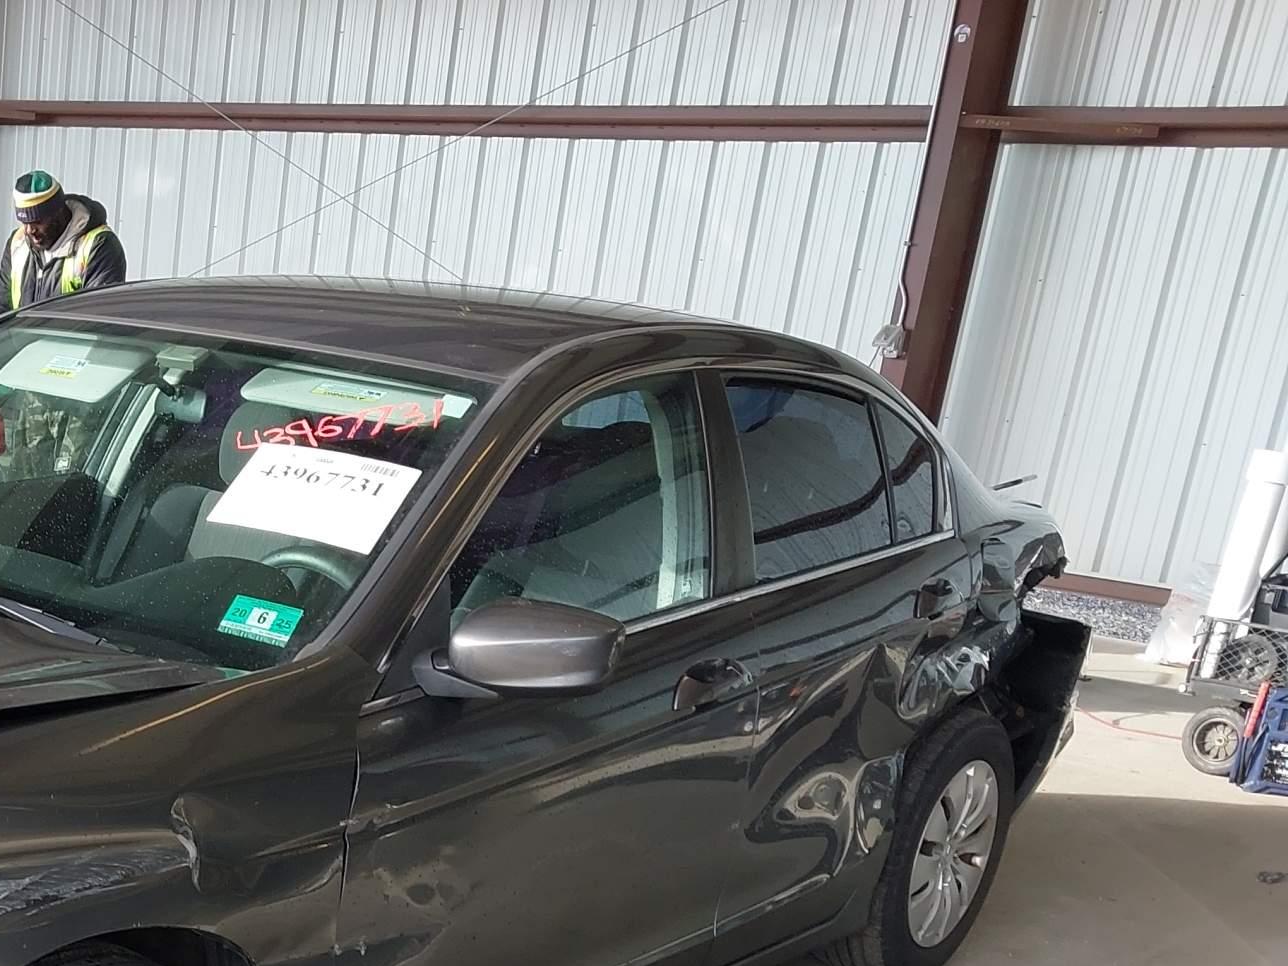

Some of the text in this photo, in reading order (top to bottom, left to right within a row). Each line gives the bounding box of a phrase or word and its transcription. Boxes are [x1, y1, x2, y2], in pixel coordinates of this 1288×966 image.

[236, 398, 444, 450] 43967731
[260, 463, 385, 497] 43967731
[231, 607, 292, 630] 20 6 25
